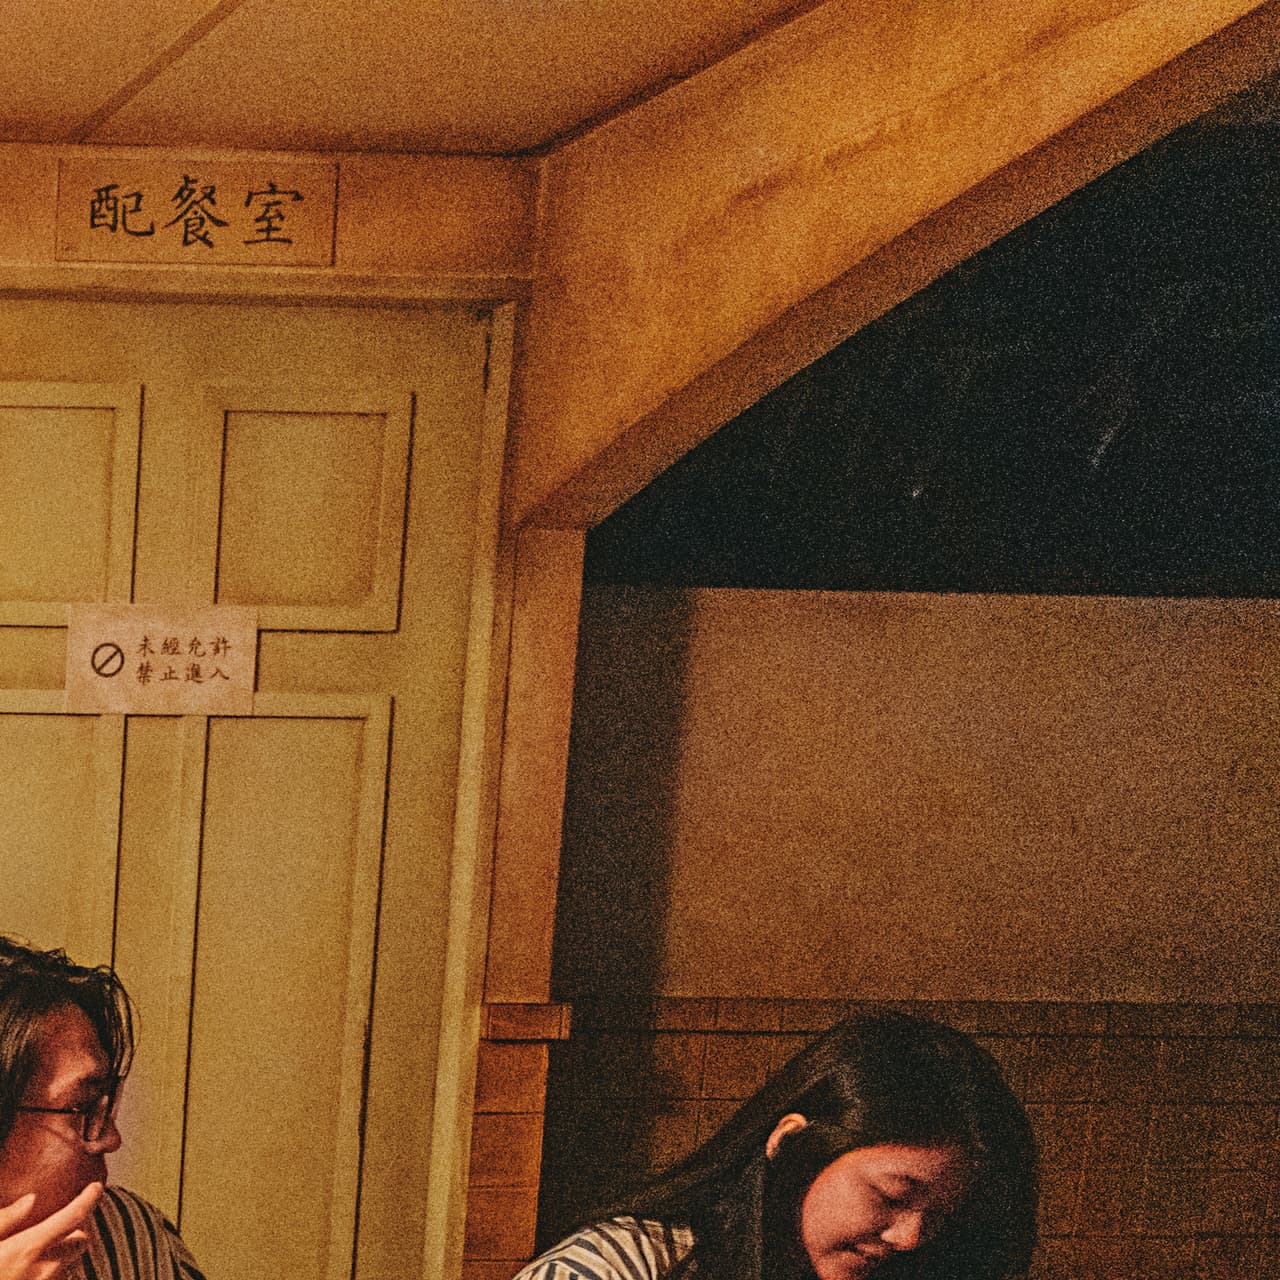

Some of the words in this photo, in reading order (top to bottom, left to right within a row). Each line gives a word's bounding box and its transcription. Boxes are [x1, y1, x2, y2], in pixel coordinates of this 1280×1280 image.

[90, 174, 304, 248] 配餐室
[136, 635, 232, 659] 未經允許
[135, 659, 231, 686] 禁止進入
